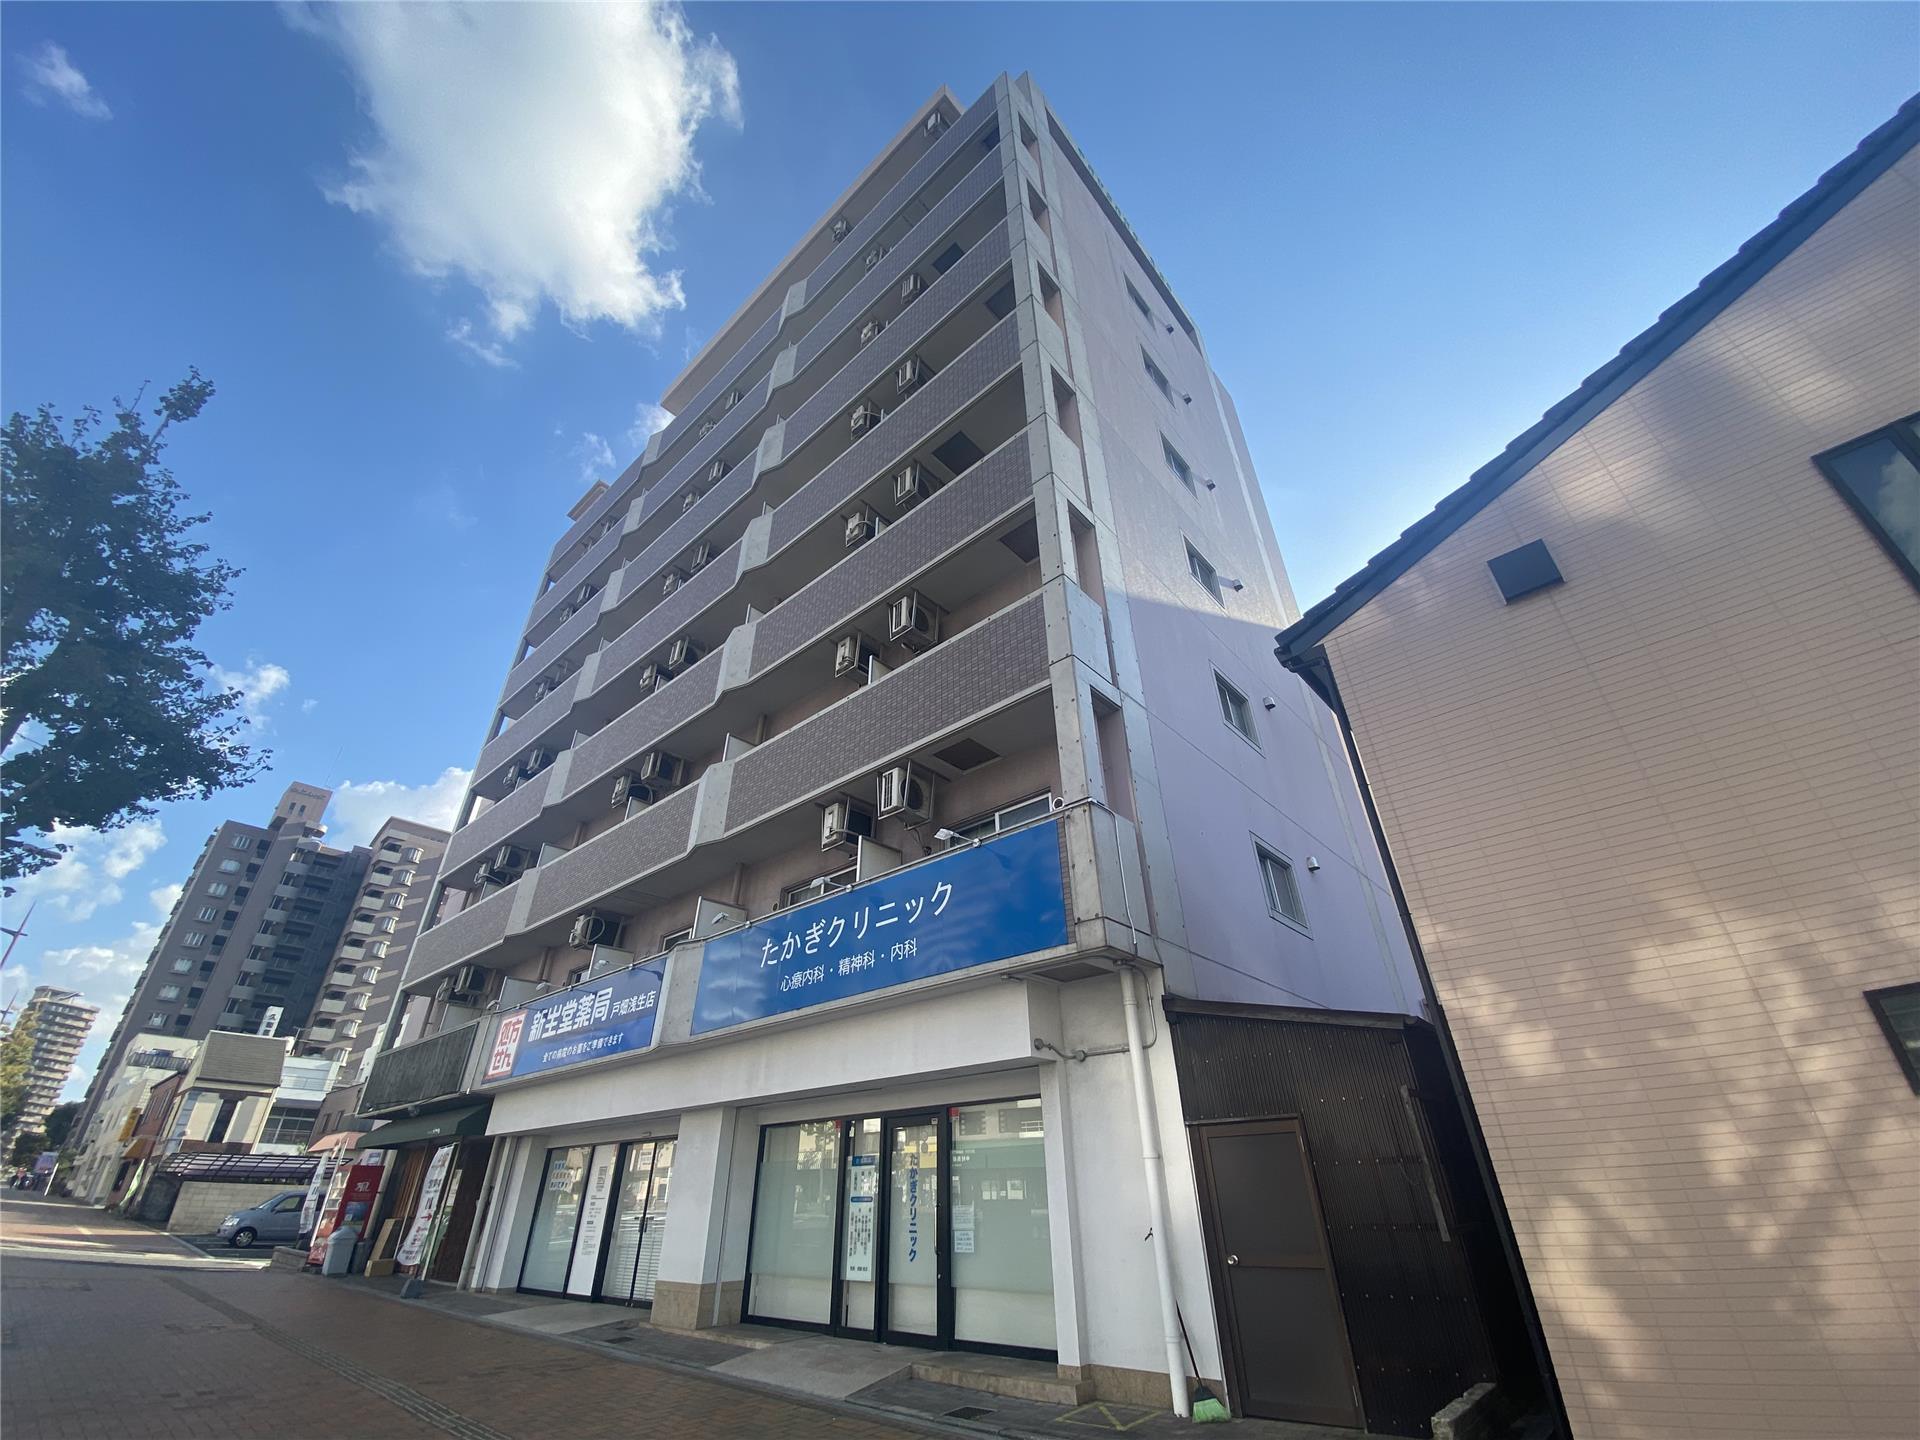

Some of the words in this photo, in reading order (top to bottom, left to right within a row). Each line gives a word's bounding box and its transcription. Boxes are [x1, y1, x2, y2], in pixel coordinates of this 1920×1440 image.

[760, 881, 952, 968] たかぎクリニック
[528, 987, 613, 1042] 新生堂薬局
[610, 991, 657, 1019] 戸畑浅生店
[497, 1018, 522, 1047] 処方
[491, 1049, 511, 1071] せん
[908, 1154, 919, 1262] たかぎクリニック
